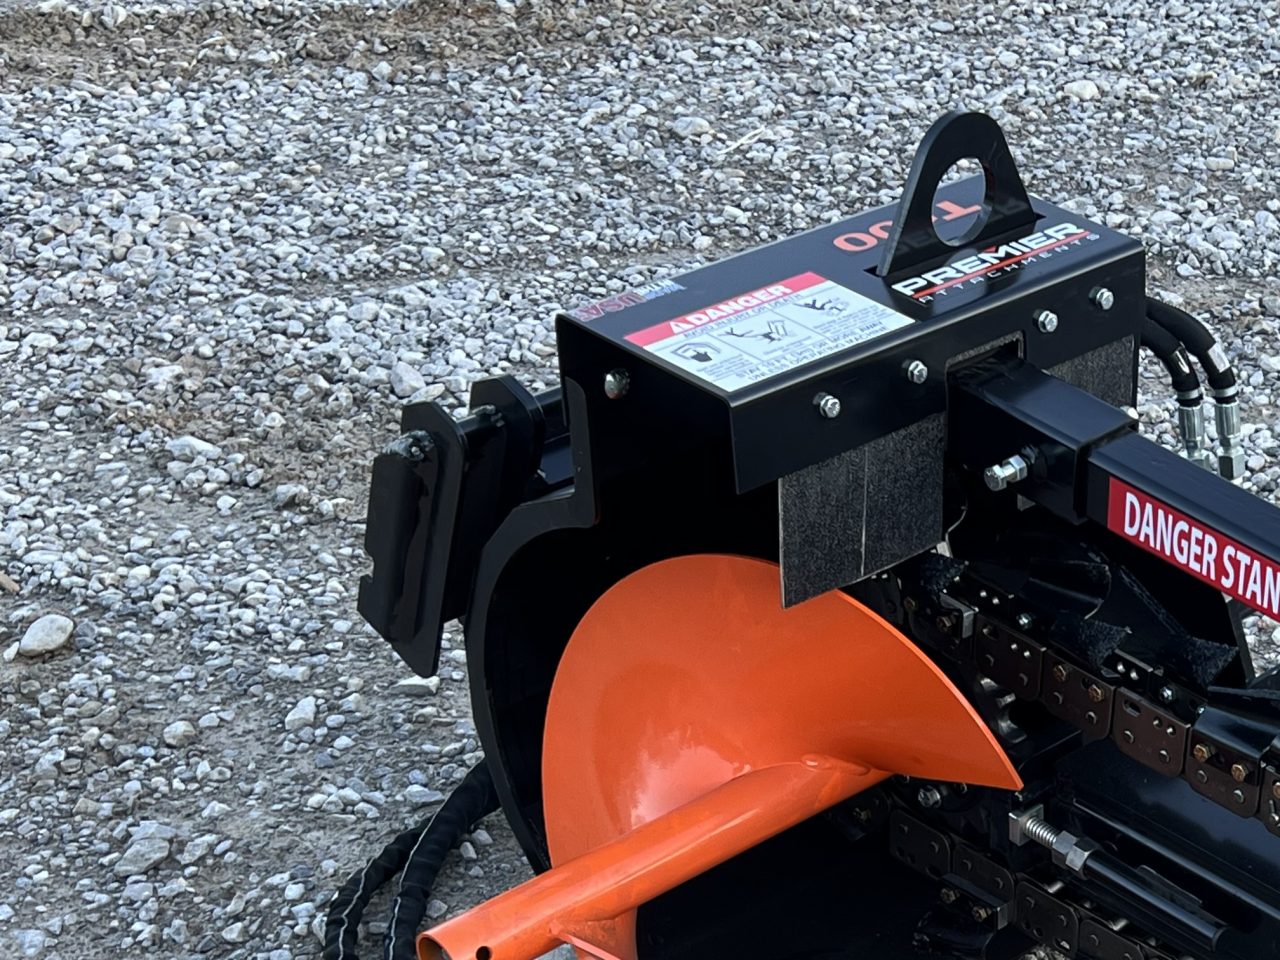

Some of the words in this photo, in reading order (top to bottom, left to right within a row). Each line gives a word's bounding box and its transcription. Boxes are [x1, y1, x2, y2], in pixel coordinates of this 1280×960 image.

[891, 222, 1086, 298] PREMIER
[918, 233, 1100, 304] ATTACHMENTS
[685, 284, 794, 327] DANGER
[1123, 491, 1218, 581] DANGER
